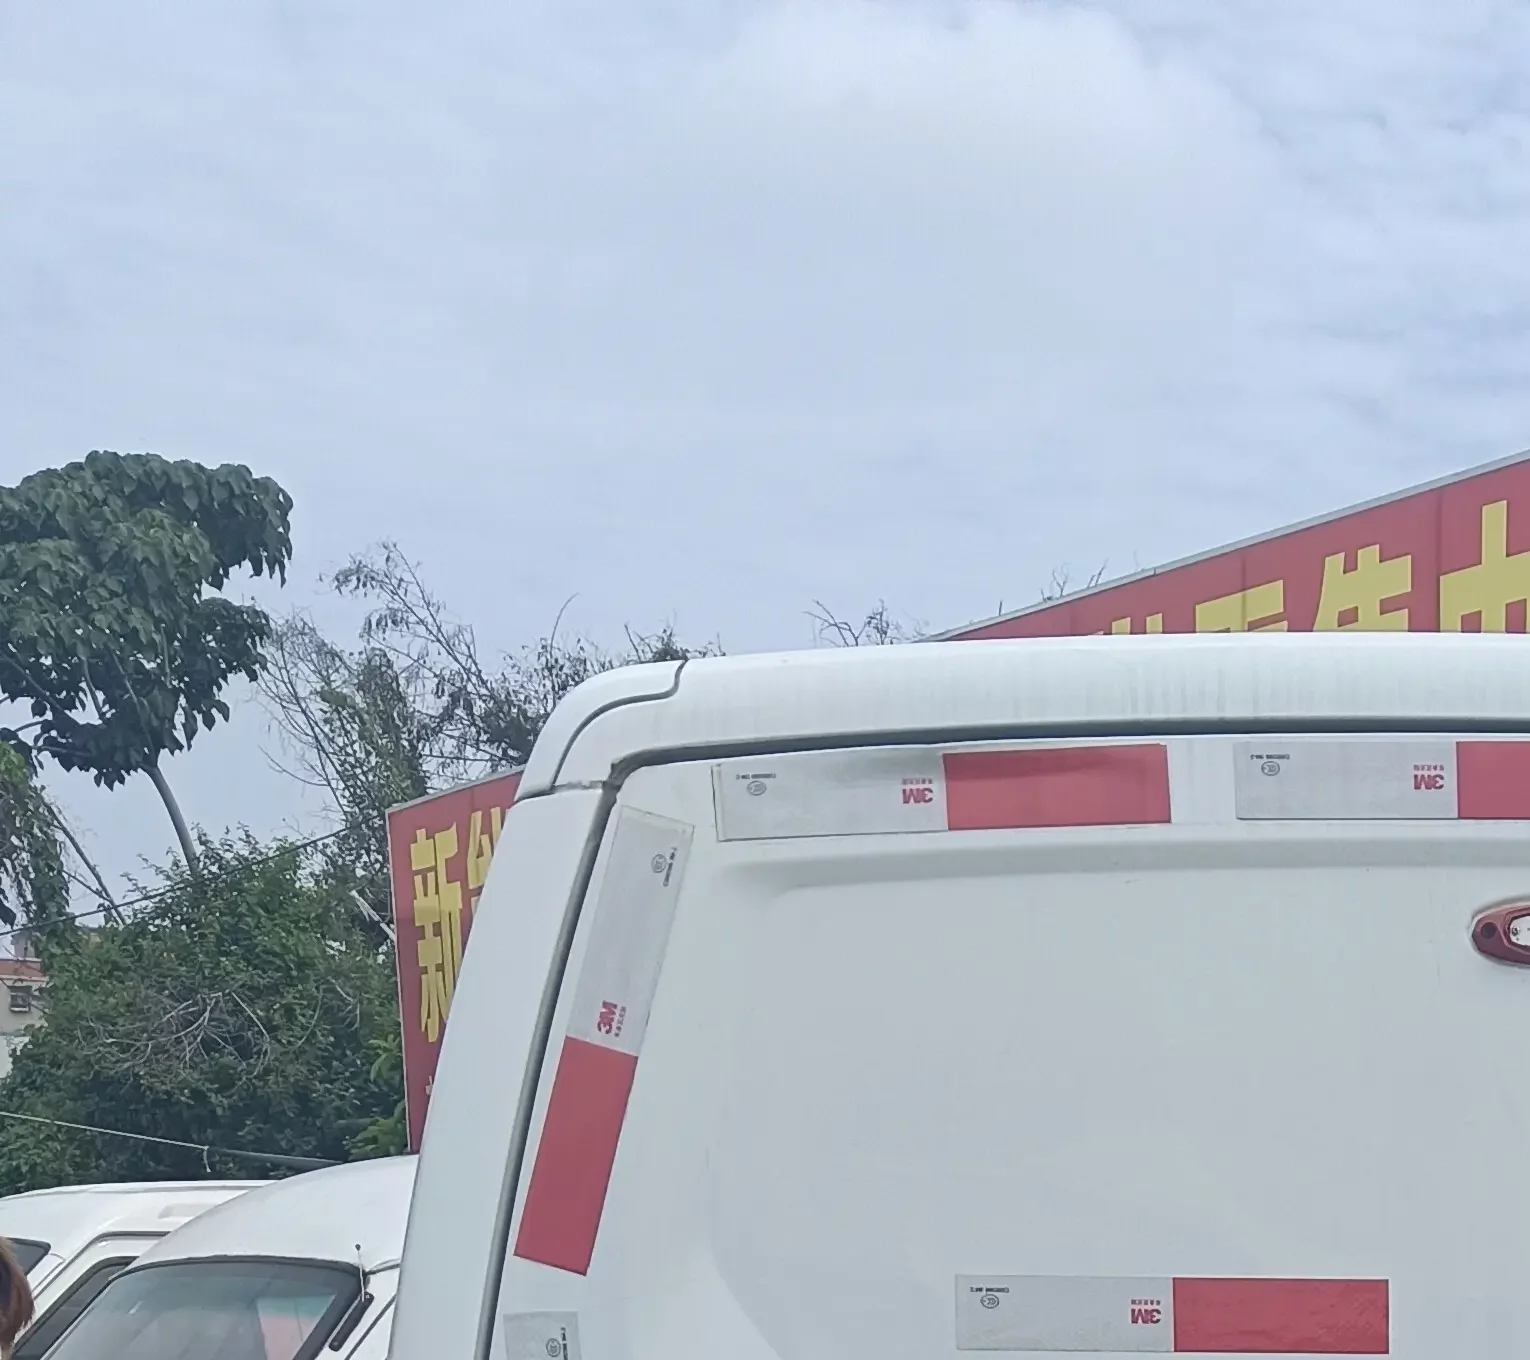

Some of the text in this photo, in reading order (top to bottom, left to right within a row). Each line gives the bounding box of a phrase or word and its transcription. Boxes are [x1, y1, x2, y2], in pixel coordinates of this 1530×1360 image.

[1413, 773, 1445, 790] 3M
[901, 787, 933, 804] 3M
[597, 1000, 617, 1035] 3M
[1130, 1308, 1161, 1324] 3M
